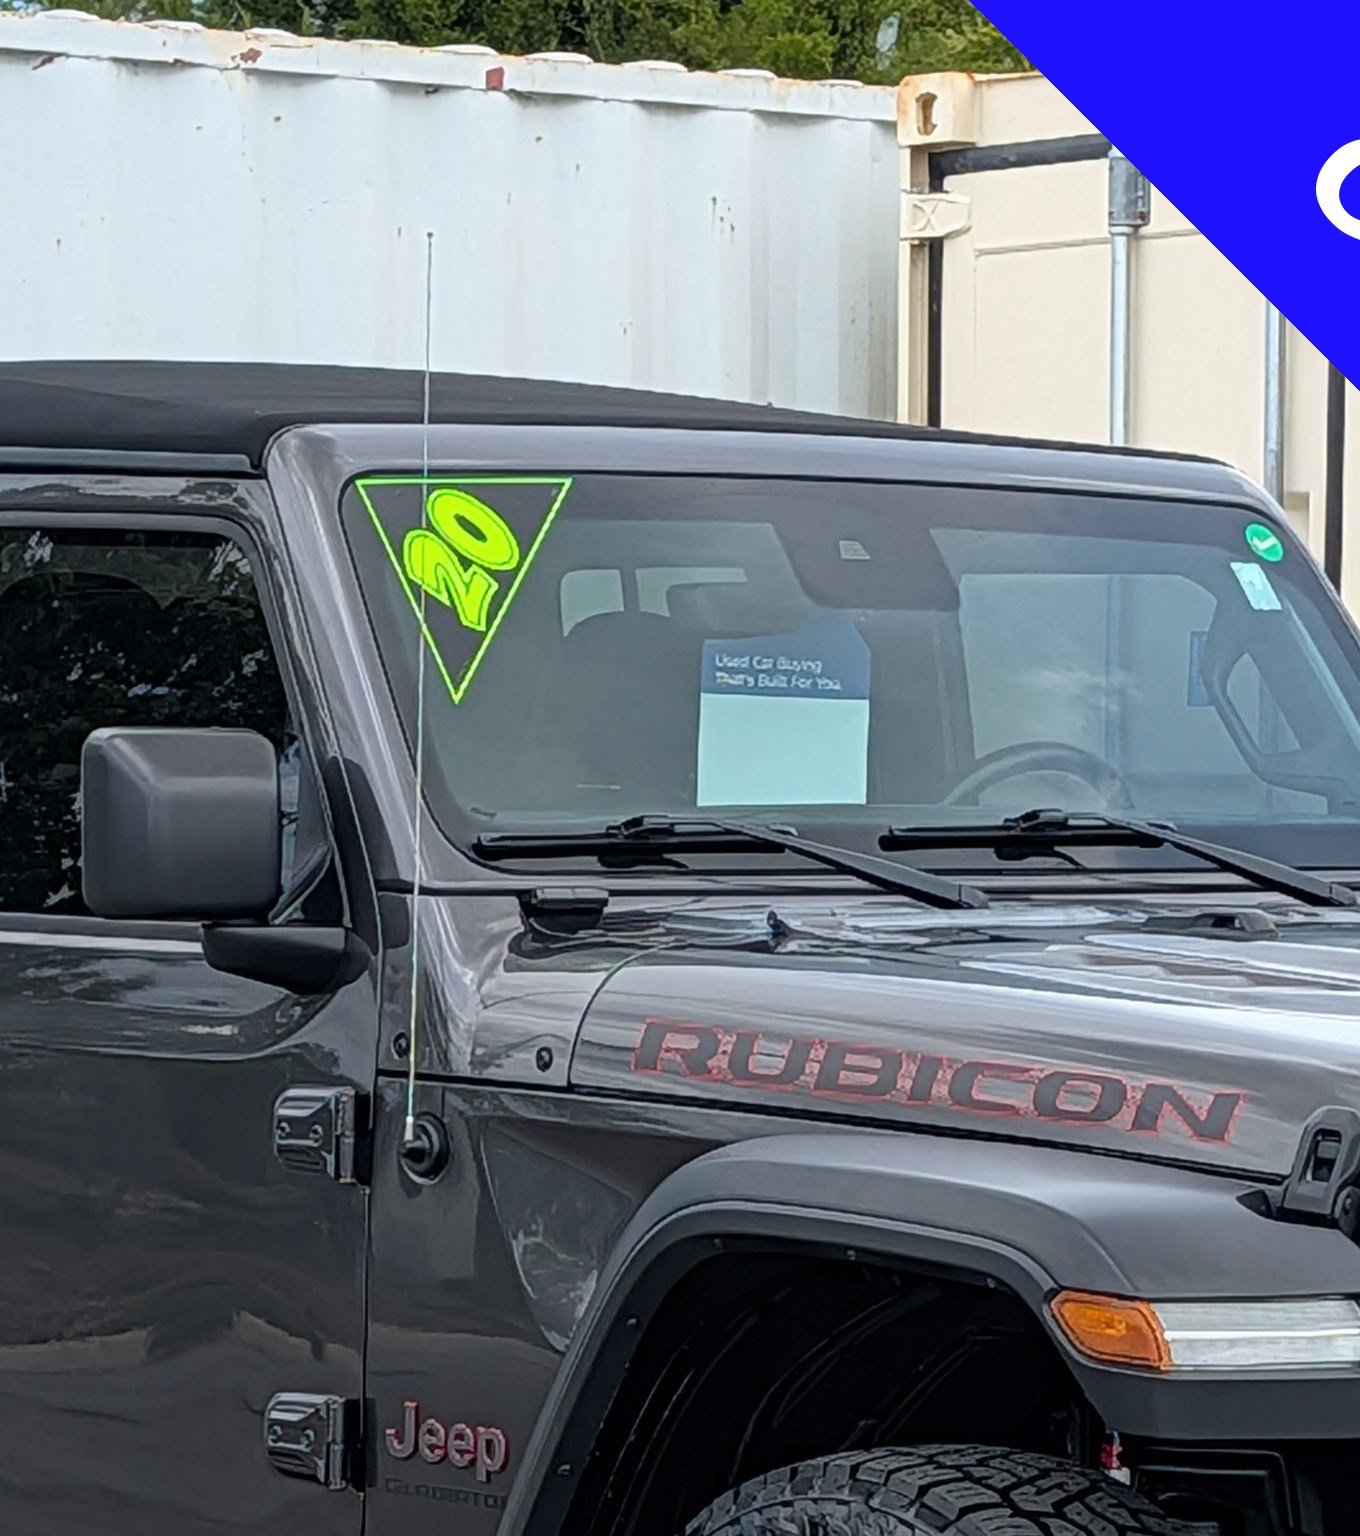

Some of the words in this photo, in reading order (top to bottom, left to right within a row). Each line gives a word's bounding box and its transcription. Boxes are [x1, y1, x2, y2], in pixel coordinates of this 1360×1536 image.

[403, 488, 520, 632] 20
[715, 654, 750, 668] Used
[752, 655, 775, 670] Car
[776, 656, 823, 674] Buying
[715, 671, 755, 688] That's
[757, 673, 788, 688] Built
[791, 676, 813, 688] For
[631, 1018, 1247, 1145] RUBICON
[385, 1401, 509, 1483] Jeep
